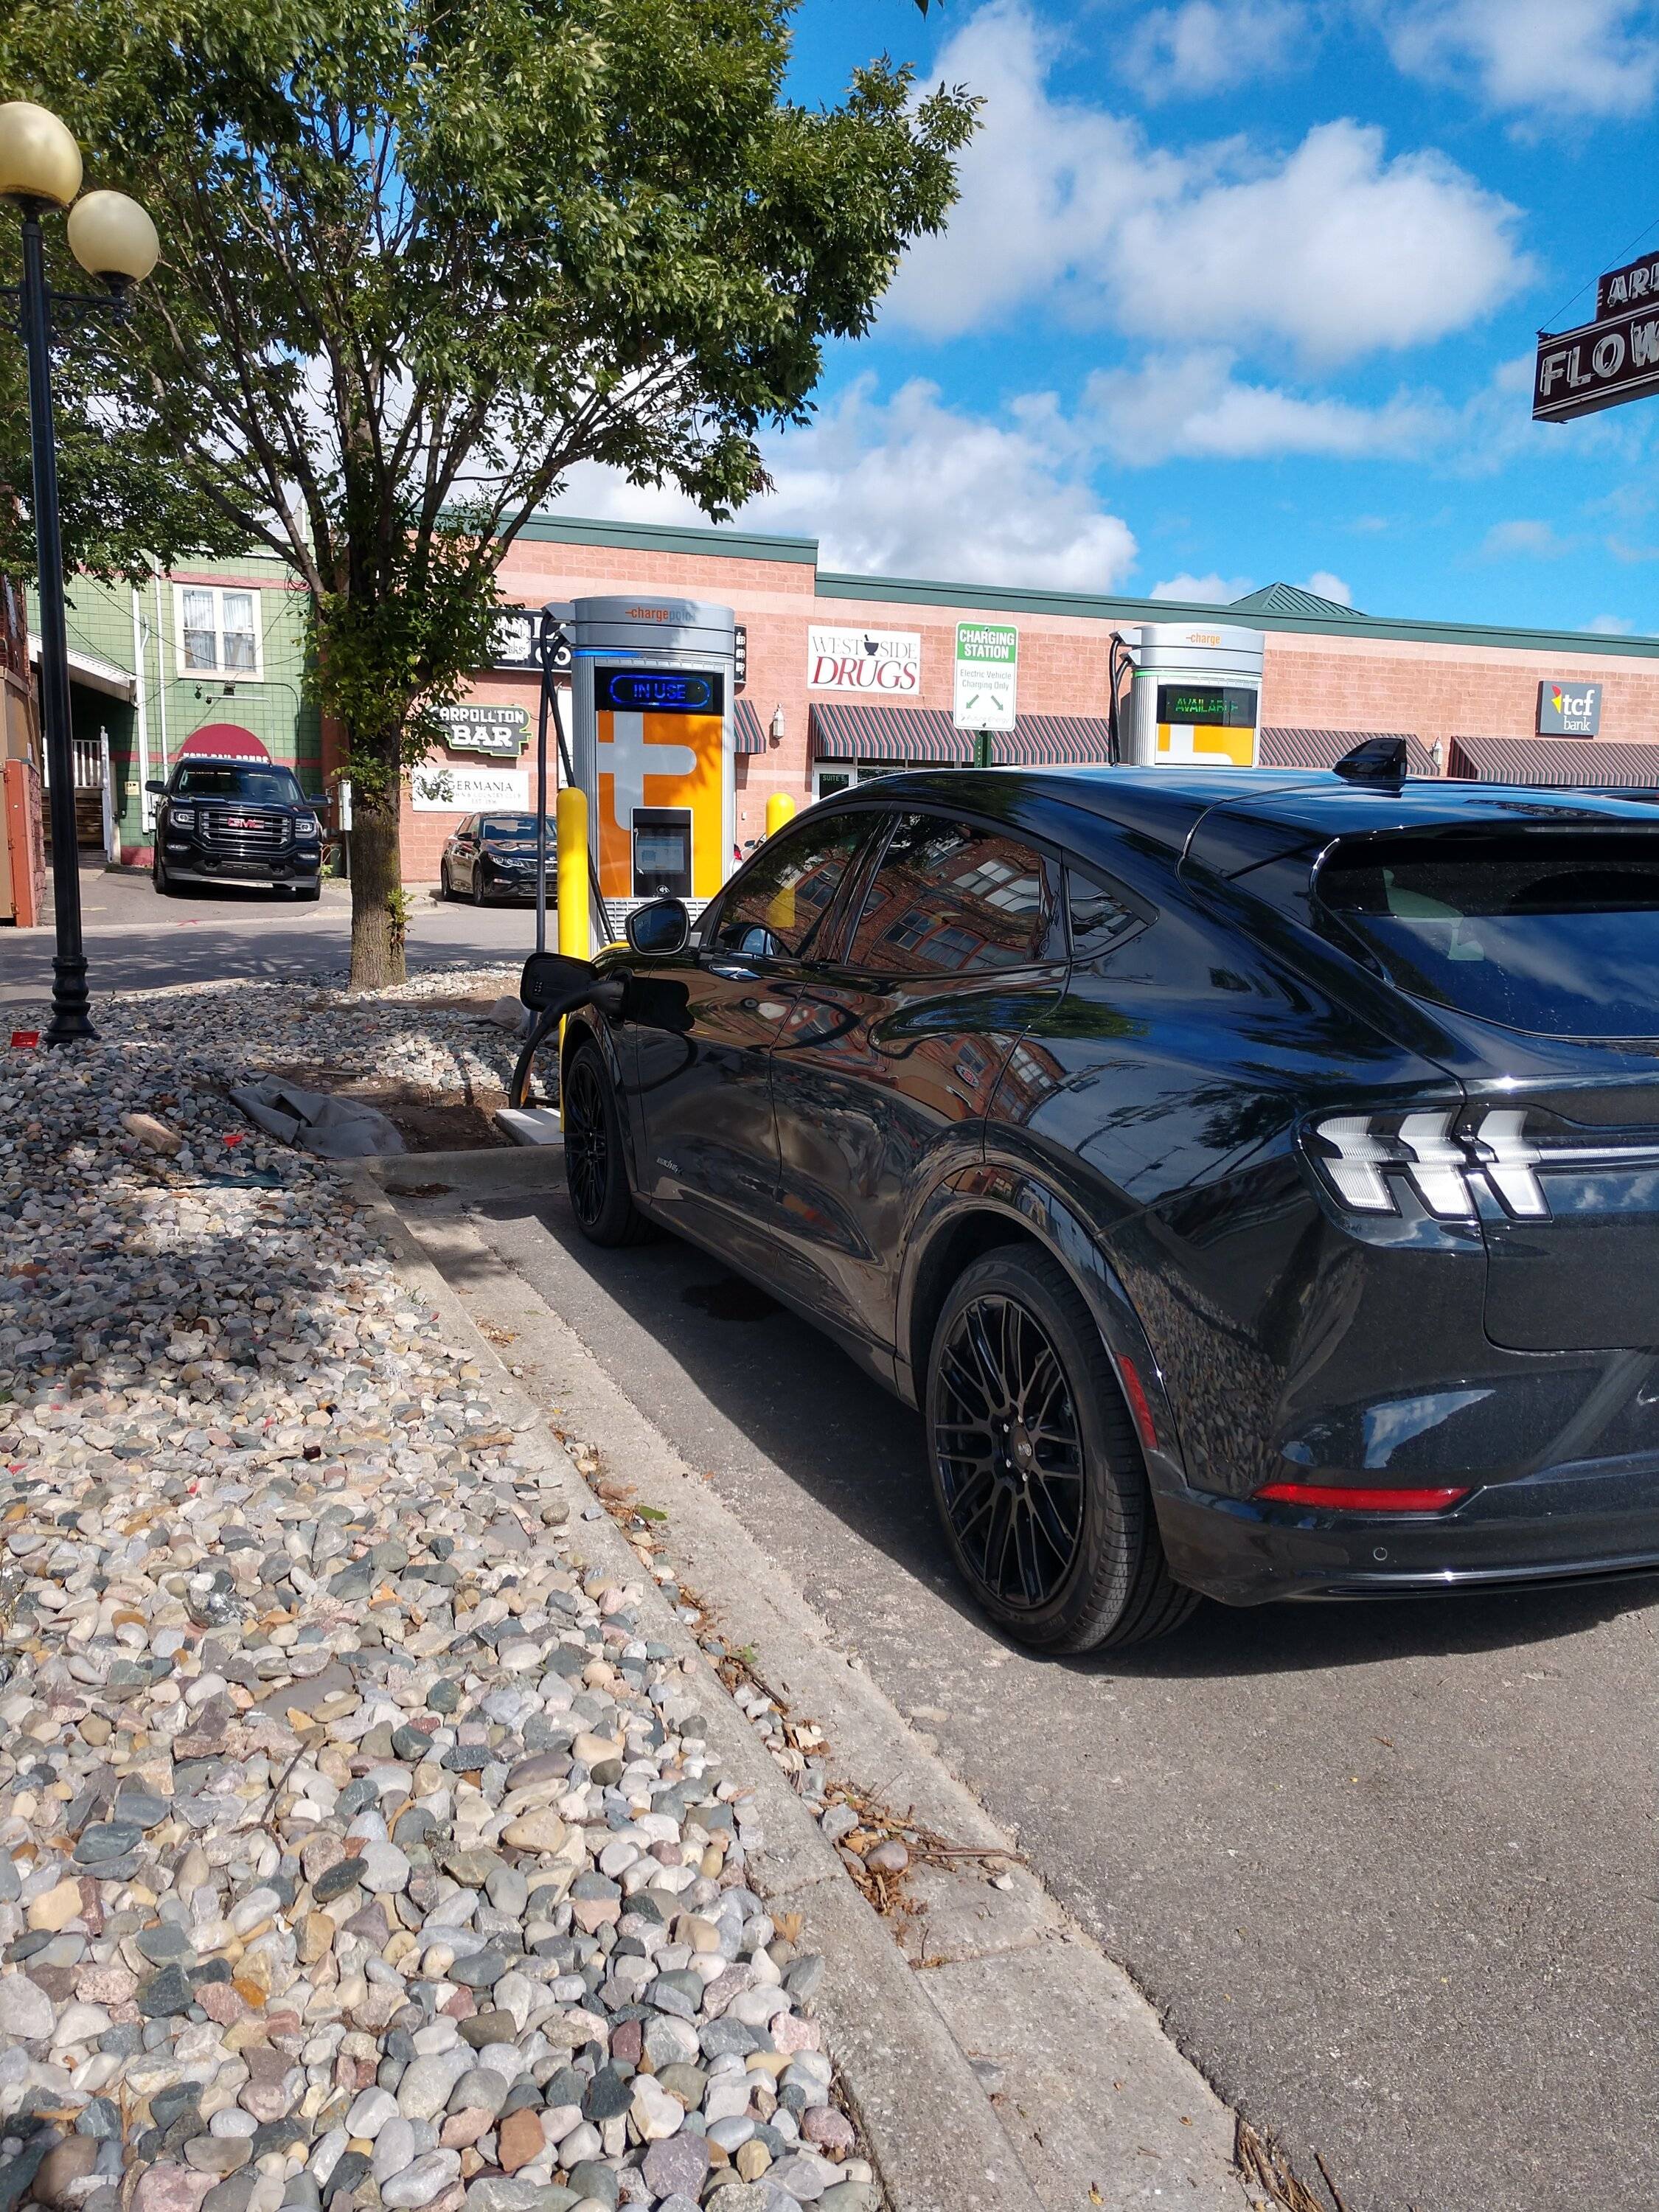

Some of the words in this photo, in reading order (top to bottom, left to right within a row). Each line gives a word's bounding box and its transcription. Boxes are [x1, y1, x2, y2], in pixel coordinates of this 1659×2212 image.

[959, 629, 1015, 646] CHARGING
[812, 636, 863, 655] WEST
[880, 640, 917, 659] SIDE
[964, 643, 1009, 659] STATION
[810, 655, 917, 690] DRUGS
[960, 668, 985, 678] Electric
[987, 669, 1012, 680] Vehicle
[633, 683, 650, 698] IN
[653, 683, 686, 699] USE
[961, 679, 992, 690] Charging
[994, 681, 1009, 691] Only
[1562, 689, 1595, 716] tcf
[1563, 715, 1591, 731] bank
[451, 724, 513, 748] BAR
[447, 780, 513, 792] GERMANIA
[227, 817, 265, 830] GMC
